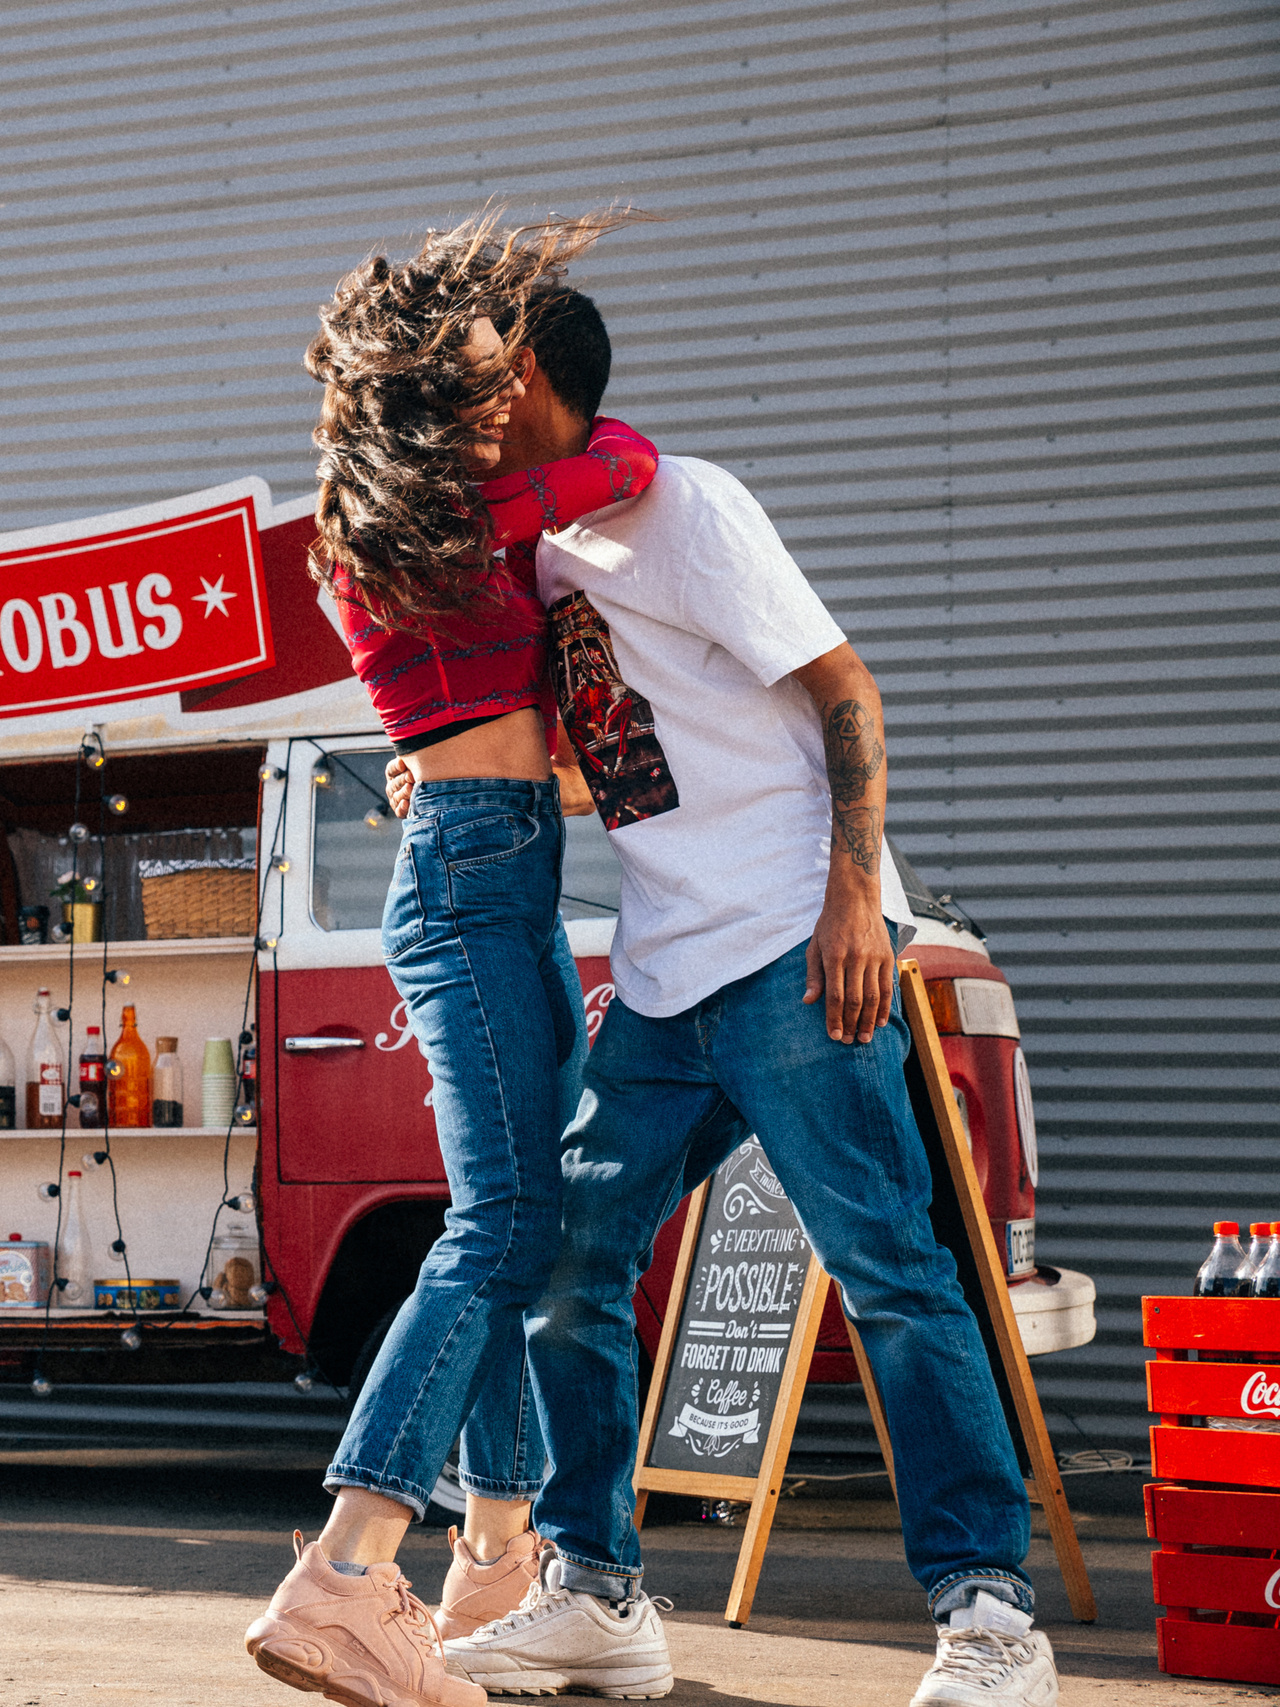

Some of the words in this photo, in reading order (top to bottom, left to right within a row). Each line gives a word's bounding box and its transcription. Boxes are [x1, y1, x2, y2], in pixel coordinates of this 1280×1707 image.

[723, 1227, 800, 1253] EVERYTHING
[700, 1260, 800, 1315] POSSIBLE
[724, 1319, 758, 1340] Don't
[680, 1343, 731, 1371] FORGET
[730, 1346, 748, 1372] TO
[746, 1347, 785, 1373] DRINK
[706, 1378, 748, 1415] Coffee
[688, 1413, 716, 1430] BECAUSE
[729, 1418, 750, 1430] GOOD
